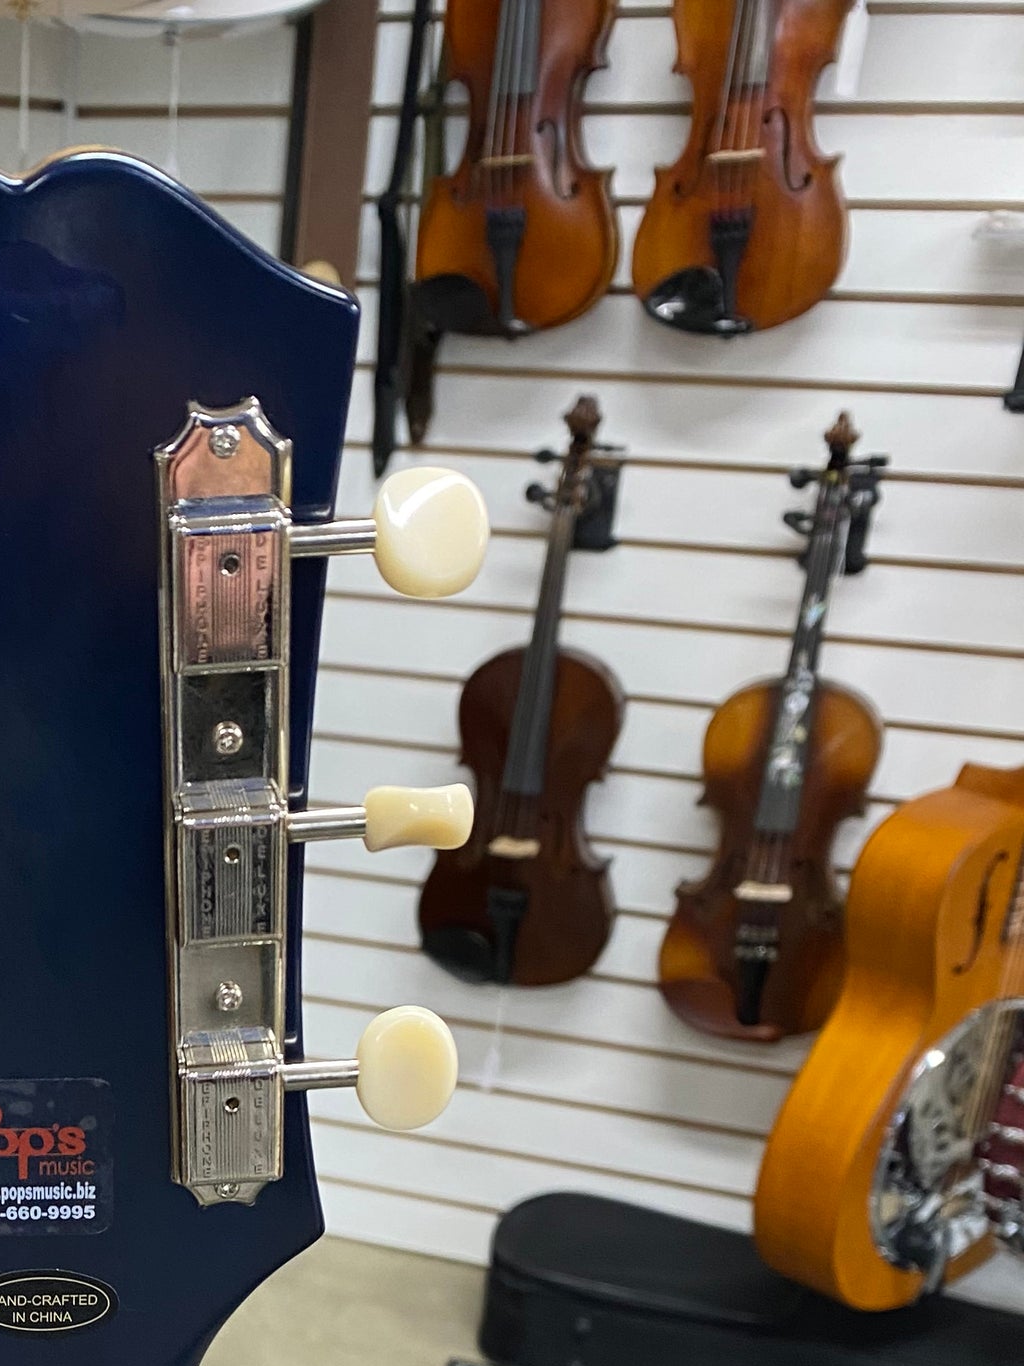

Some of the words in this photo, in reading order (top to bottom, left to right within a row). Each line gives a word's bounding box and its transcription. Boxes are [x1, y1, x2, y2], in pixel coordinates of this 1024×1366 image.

[38, 1157, 96, 1176] music
[12, 1312, 26, 1323] IN
[29, 1311, 73, 1323] CHINA
